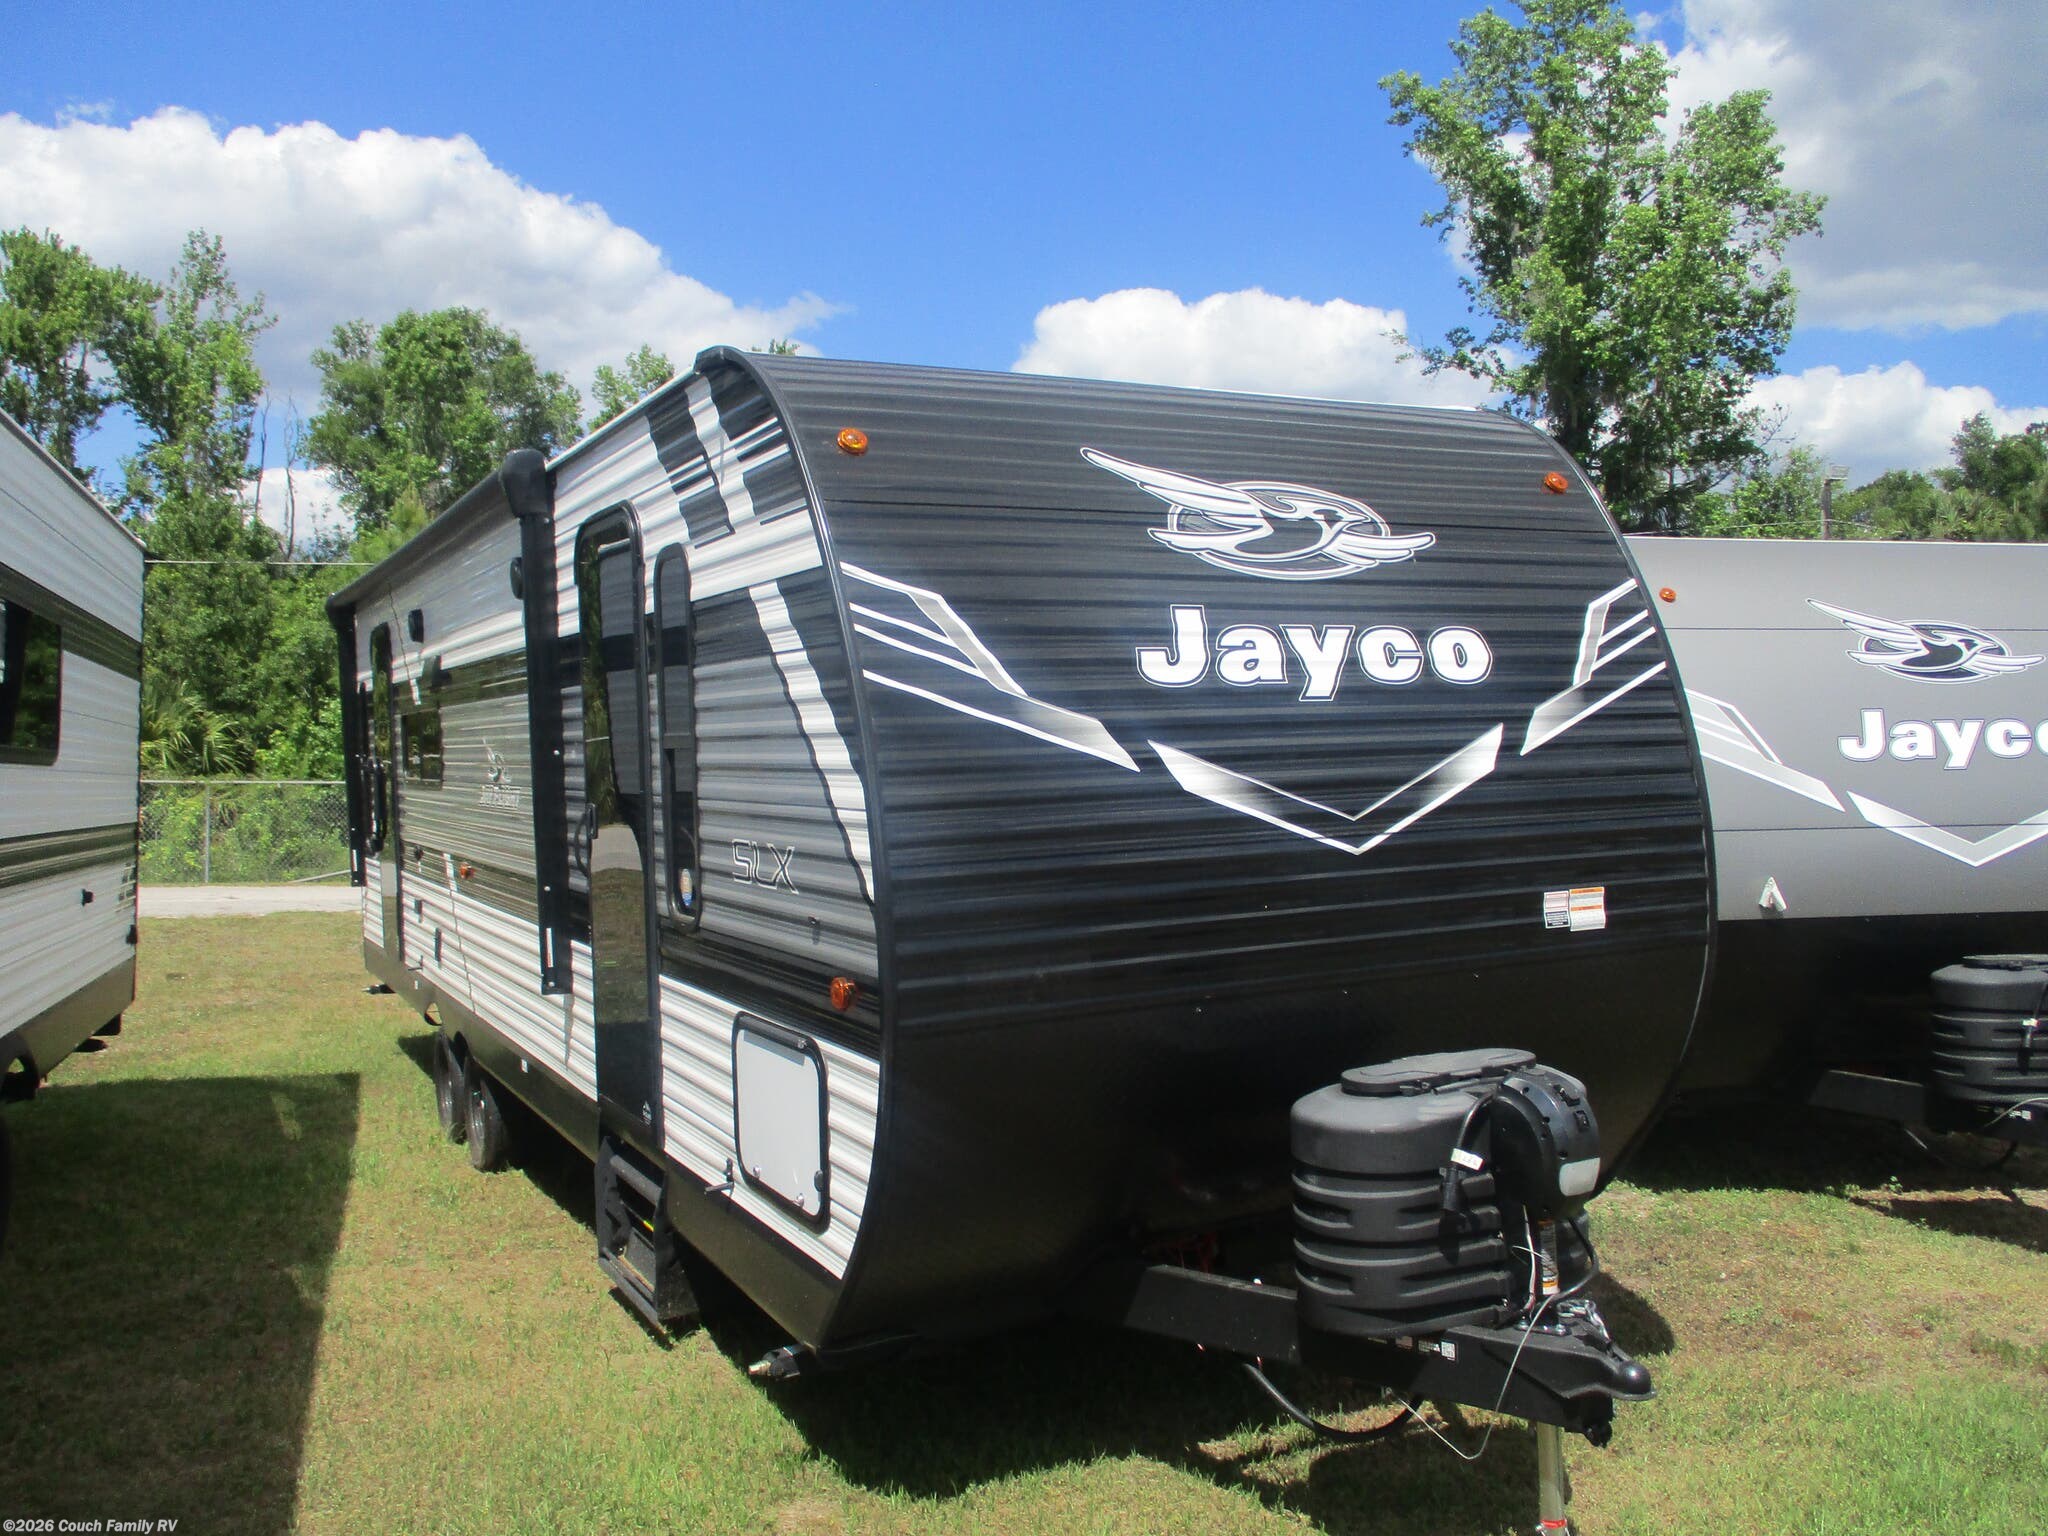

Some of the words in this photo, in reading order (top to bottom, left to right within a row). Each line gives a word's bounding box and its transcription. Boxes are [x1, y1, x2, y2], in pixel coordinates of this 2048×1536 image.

[1136, 604, 1493, 701] Jayco
[1837, 708, 2048, 770] Jayc
[732, 838, 799, 895] SLX
